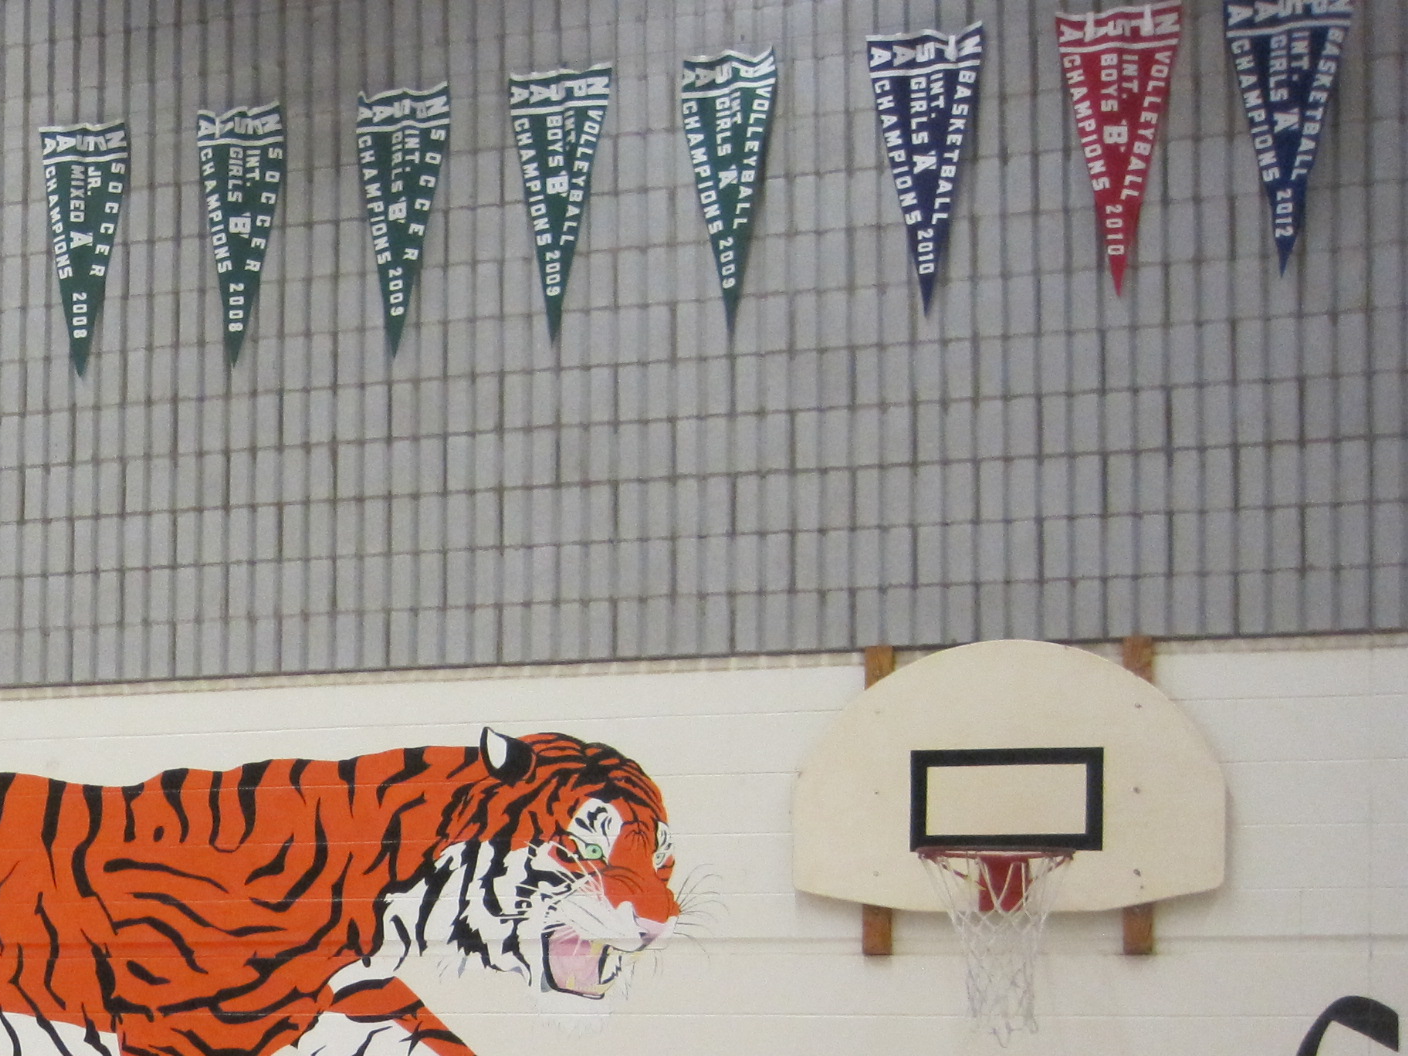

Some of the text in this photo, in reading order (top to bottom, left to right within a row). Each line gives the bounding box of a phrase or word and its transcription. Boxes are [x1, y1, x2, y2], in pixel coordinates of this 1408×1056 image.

[1101, 53, 1118, 112] BOYS
[1122, 54, 1139, 99] INT.
[1270, 34, 1288, 102] GIRLS
[1291, 30, 1310, 82] INT.
[715, 97, 731, 157] GIRLS
[910, 77, 929, 144] GIRLS
[930, 73, 944, 118] INT.
[1063, 54, 1110, 192] CHAMPIONS
[1121, 51, 1172, 200] VOLLEYBALL
[1231, 39, 1280, 182] CHAMPIONS
[1291, 27, 1344, 180] BASKETBALL
[392, 131, 403, 193] GIRLS
[546, 115, 564, 168] BOYS
[682, 101, 723, 235] CHAMPIONS
[733, 86, 772, 229] VOLLEYBALL
[874, 79, 922, 225] CHAMPIONS
[932, 70, 976, 224] BASKETBALL
[70, 165, 84, 223] MIXED
[88, 167, 101, 196] JR.
[228, 147, 242, 203] GIRLS
[358, 135, 391, 265] CHAMPIONS
[403, 128, 445, 261] SOCCER
[513, 117, 552, 246] CHAMPIONS
[560, 109, 604, 246] VOLLEYBALL
[45, 166, 73, 280] CHAMPIONS
[89, 162, 125, 277] SOCCER
[201, 147, 232, 273] CHAMPIONS
[245, 147, 283, 272] SOCCER
[1106, 204, 1124, 256] 2010
[1275, 188, 1293, 238] 2012
[544, 250, 560, 296] 2009
[718, 237, 736, 289] 2009
[917, 228, 934, 274] 2010
[73, 292, 87, 338] 2008
[229, 283, 244, 332] 2008
[388, 268, 404, 316] 2009
